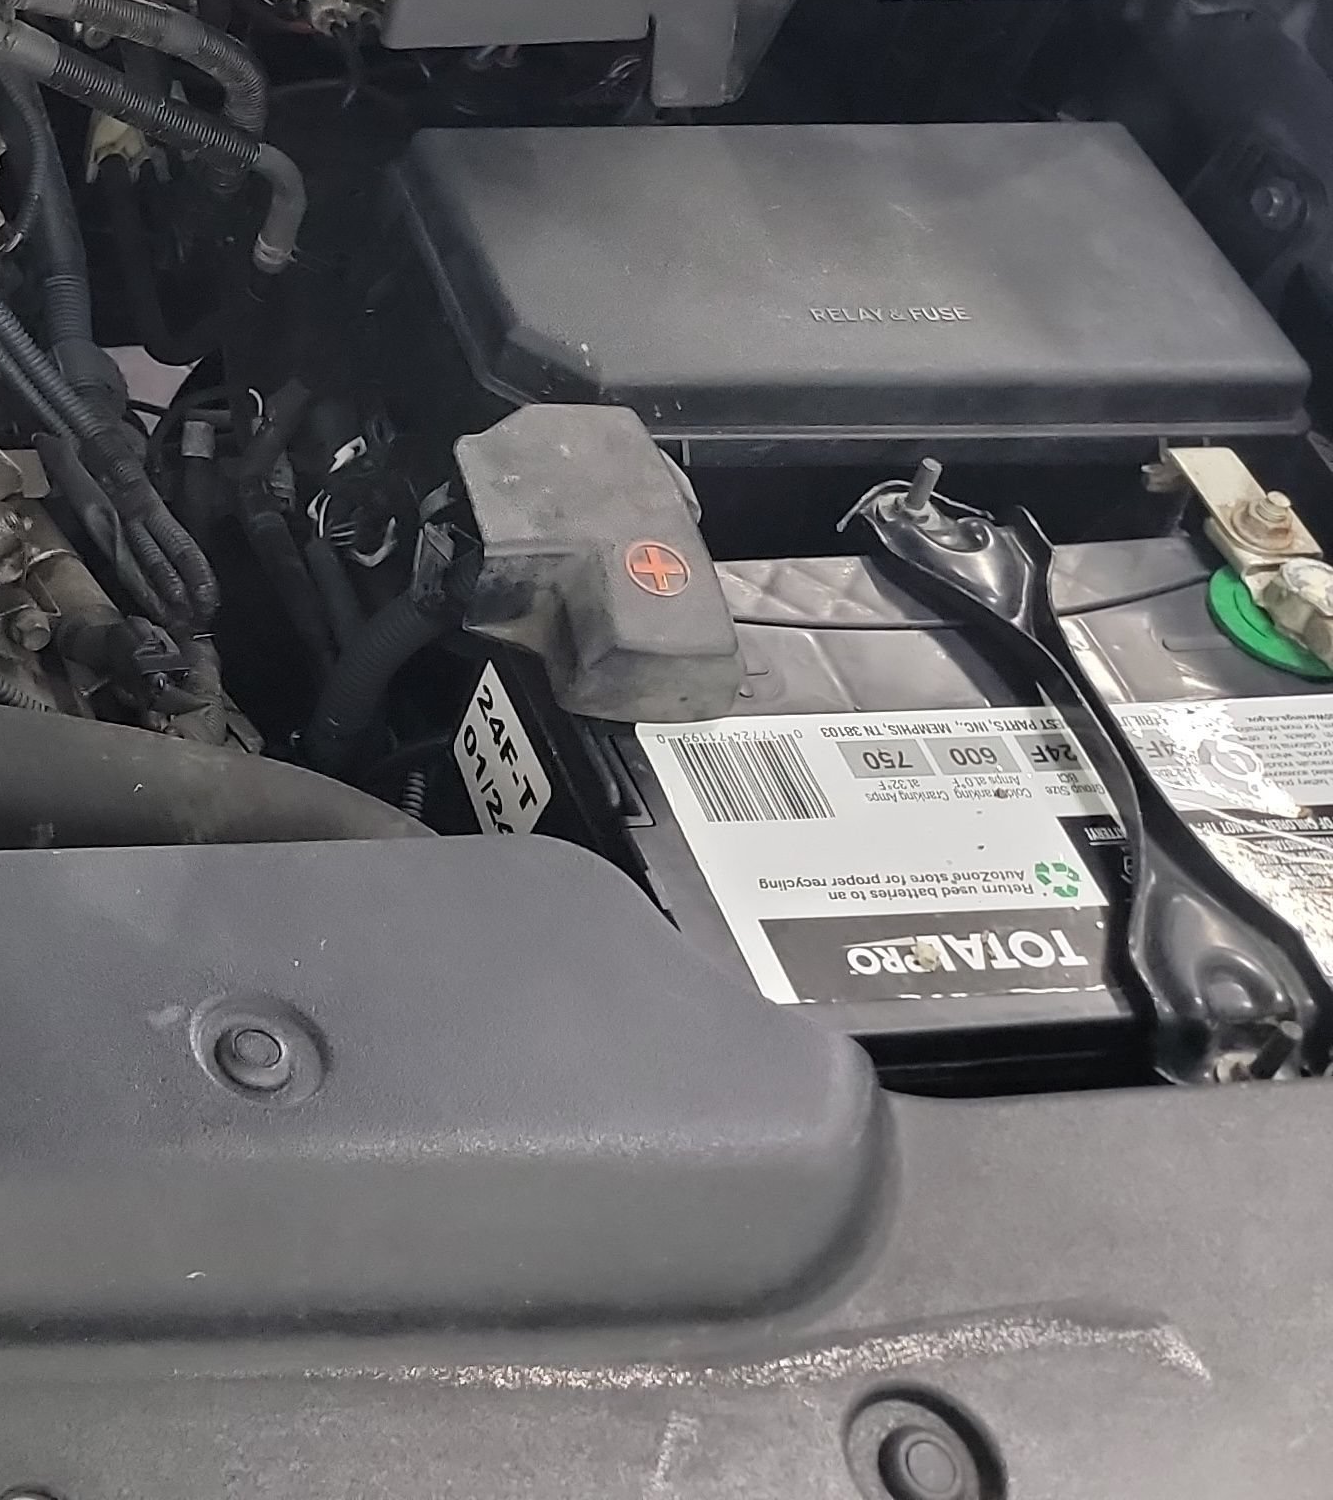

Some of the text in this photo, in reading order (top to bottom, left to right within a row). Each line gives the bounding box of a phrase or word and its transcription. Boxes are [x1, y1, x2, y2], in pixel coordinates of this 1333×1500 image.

[808, 306, 973, 323] RELAY & FUSE
[863, 725, 884, 737] TN
[883, 722, 952, 736] MEMPHIS,
[989, 719, 1037, 732] PARTS,
[1040, 718, 1065, 730] EST
[656, 729, 804, 744] 0 17724 71199 0
[820, 726, 863, 738] 38103
[476, 684, 538, 811] 24F-T
[1031, 743, 1079, 764] 24F
[862, 750, 914, 770] 750
[949, 746, 999, 766] 600
[907, 779, 921, 789] at
[975, 776, 989, 787] at
[990, 774, 1022, 787] Amps
[1057, 773, 1079, 784] BCI
[865, 790, 950, 803] Cranking Amps
[953, 787, 1001, 801] ranking
[1045, 783, 1106, 797] Group Size
[1220, 820, 1245, 834] NOT
[758, 877, 828, 891] recycling
[831, 873, 881, 887] proper
[885, 874, 907, 886] for
[909, 873, 950, 884] store
[827, 883, 1035, 901] Return used batteries to an
